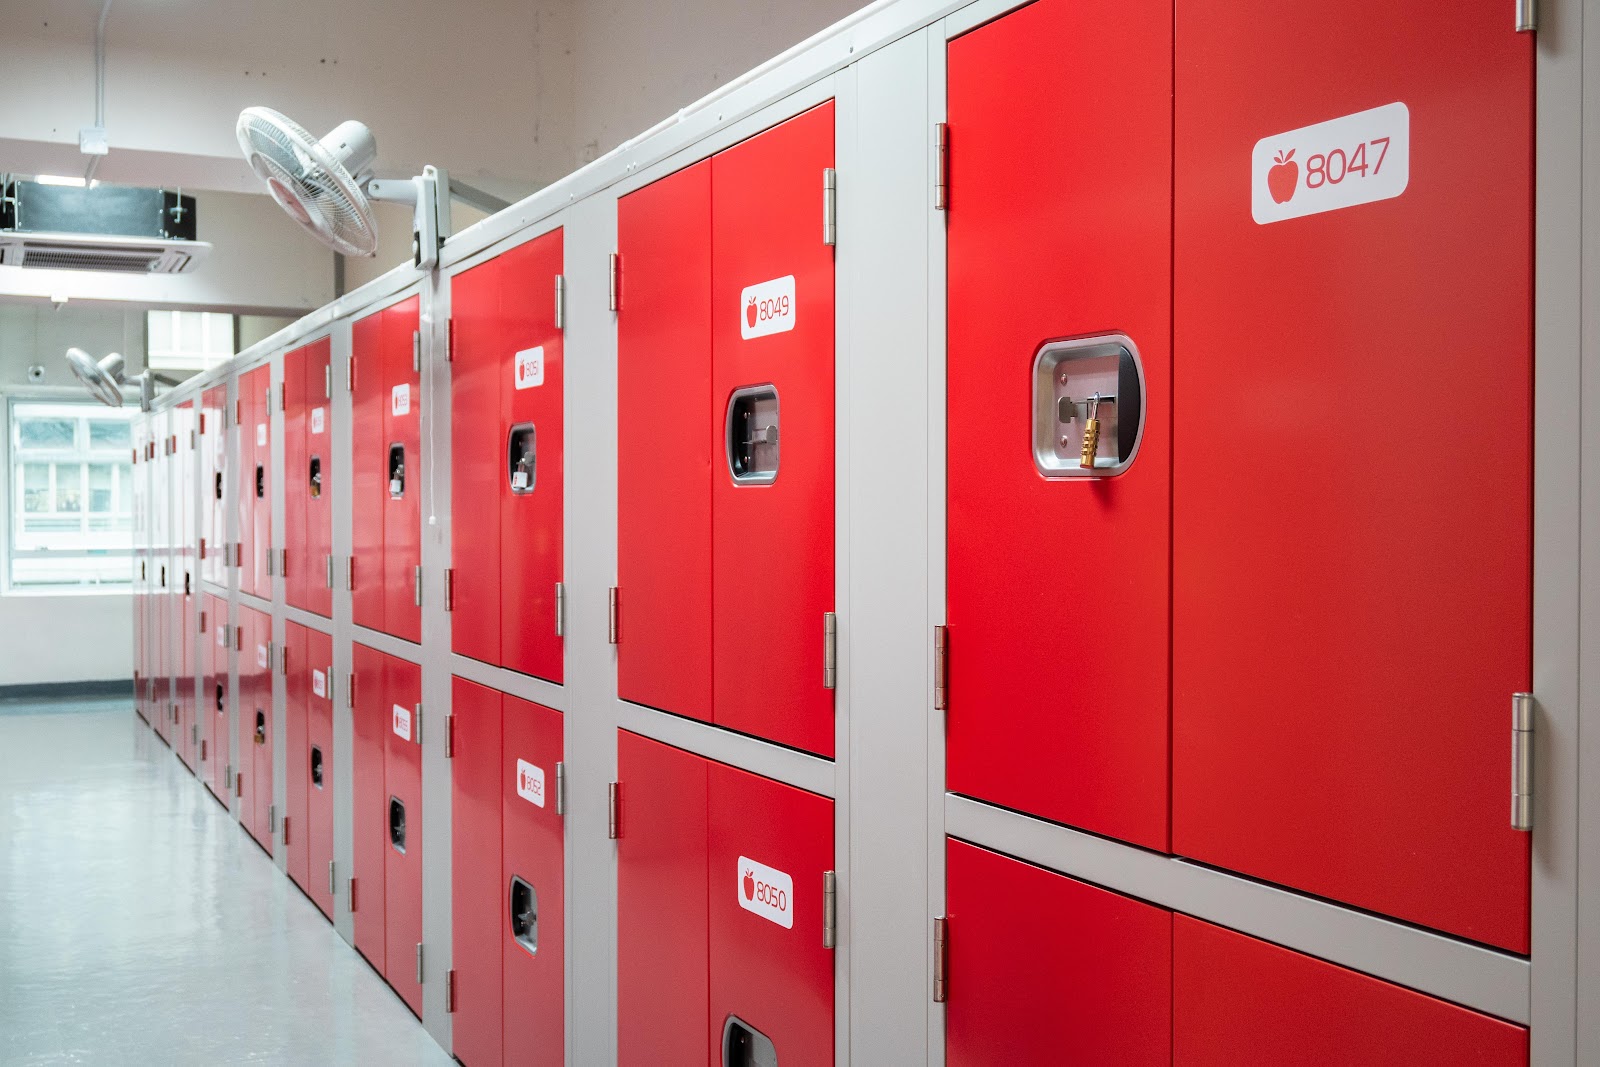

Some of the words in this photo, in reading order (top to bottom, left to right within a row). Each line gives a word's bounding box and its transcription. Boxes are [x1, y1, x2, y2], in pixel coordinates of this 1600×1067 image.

[1306, 136, 1390, 189] 8047
[760, 295, 789, 321] 8049
[757, 881, 787, 912] 8050
